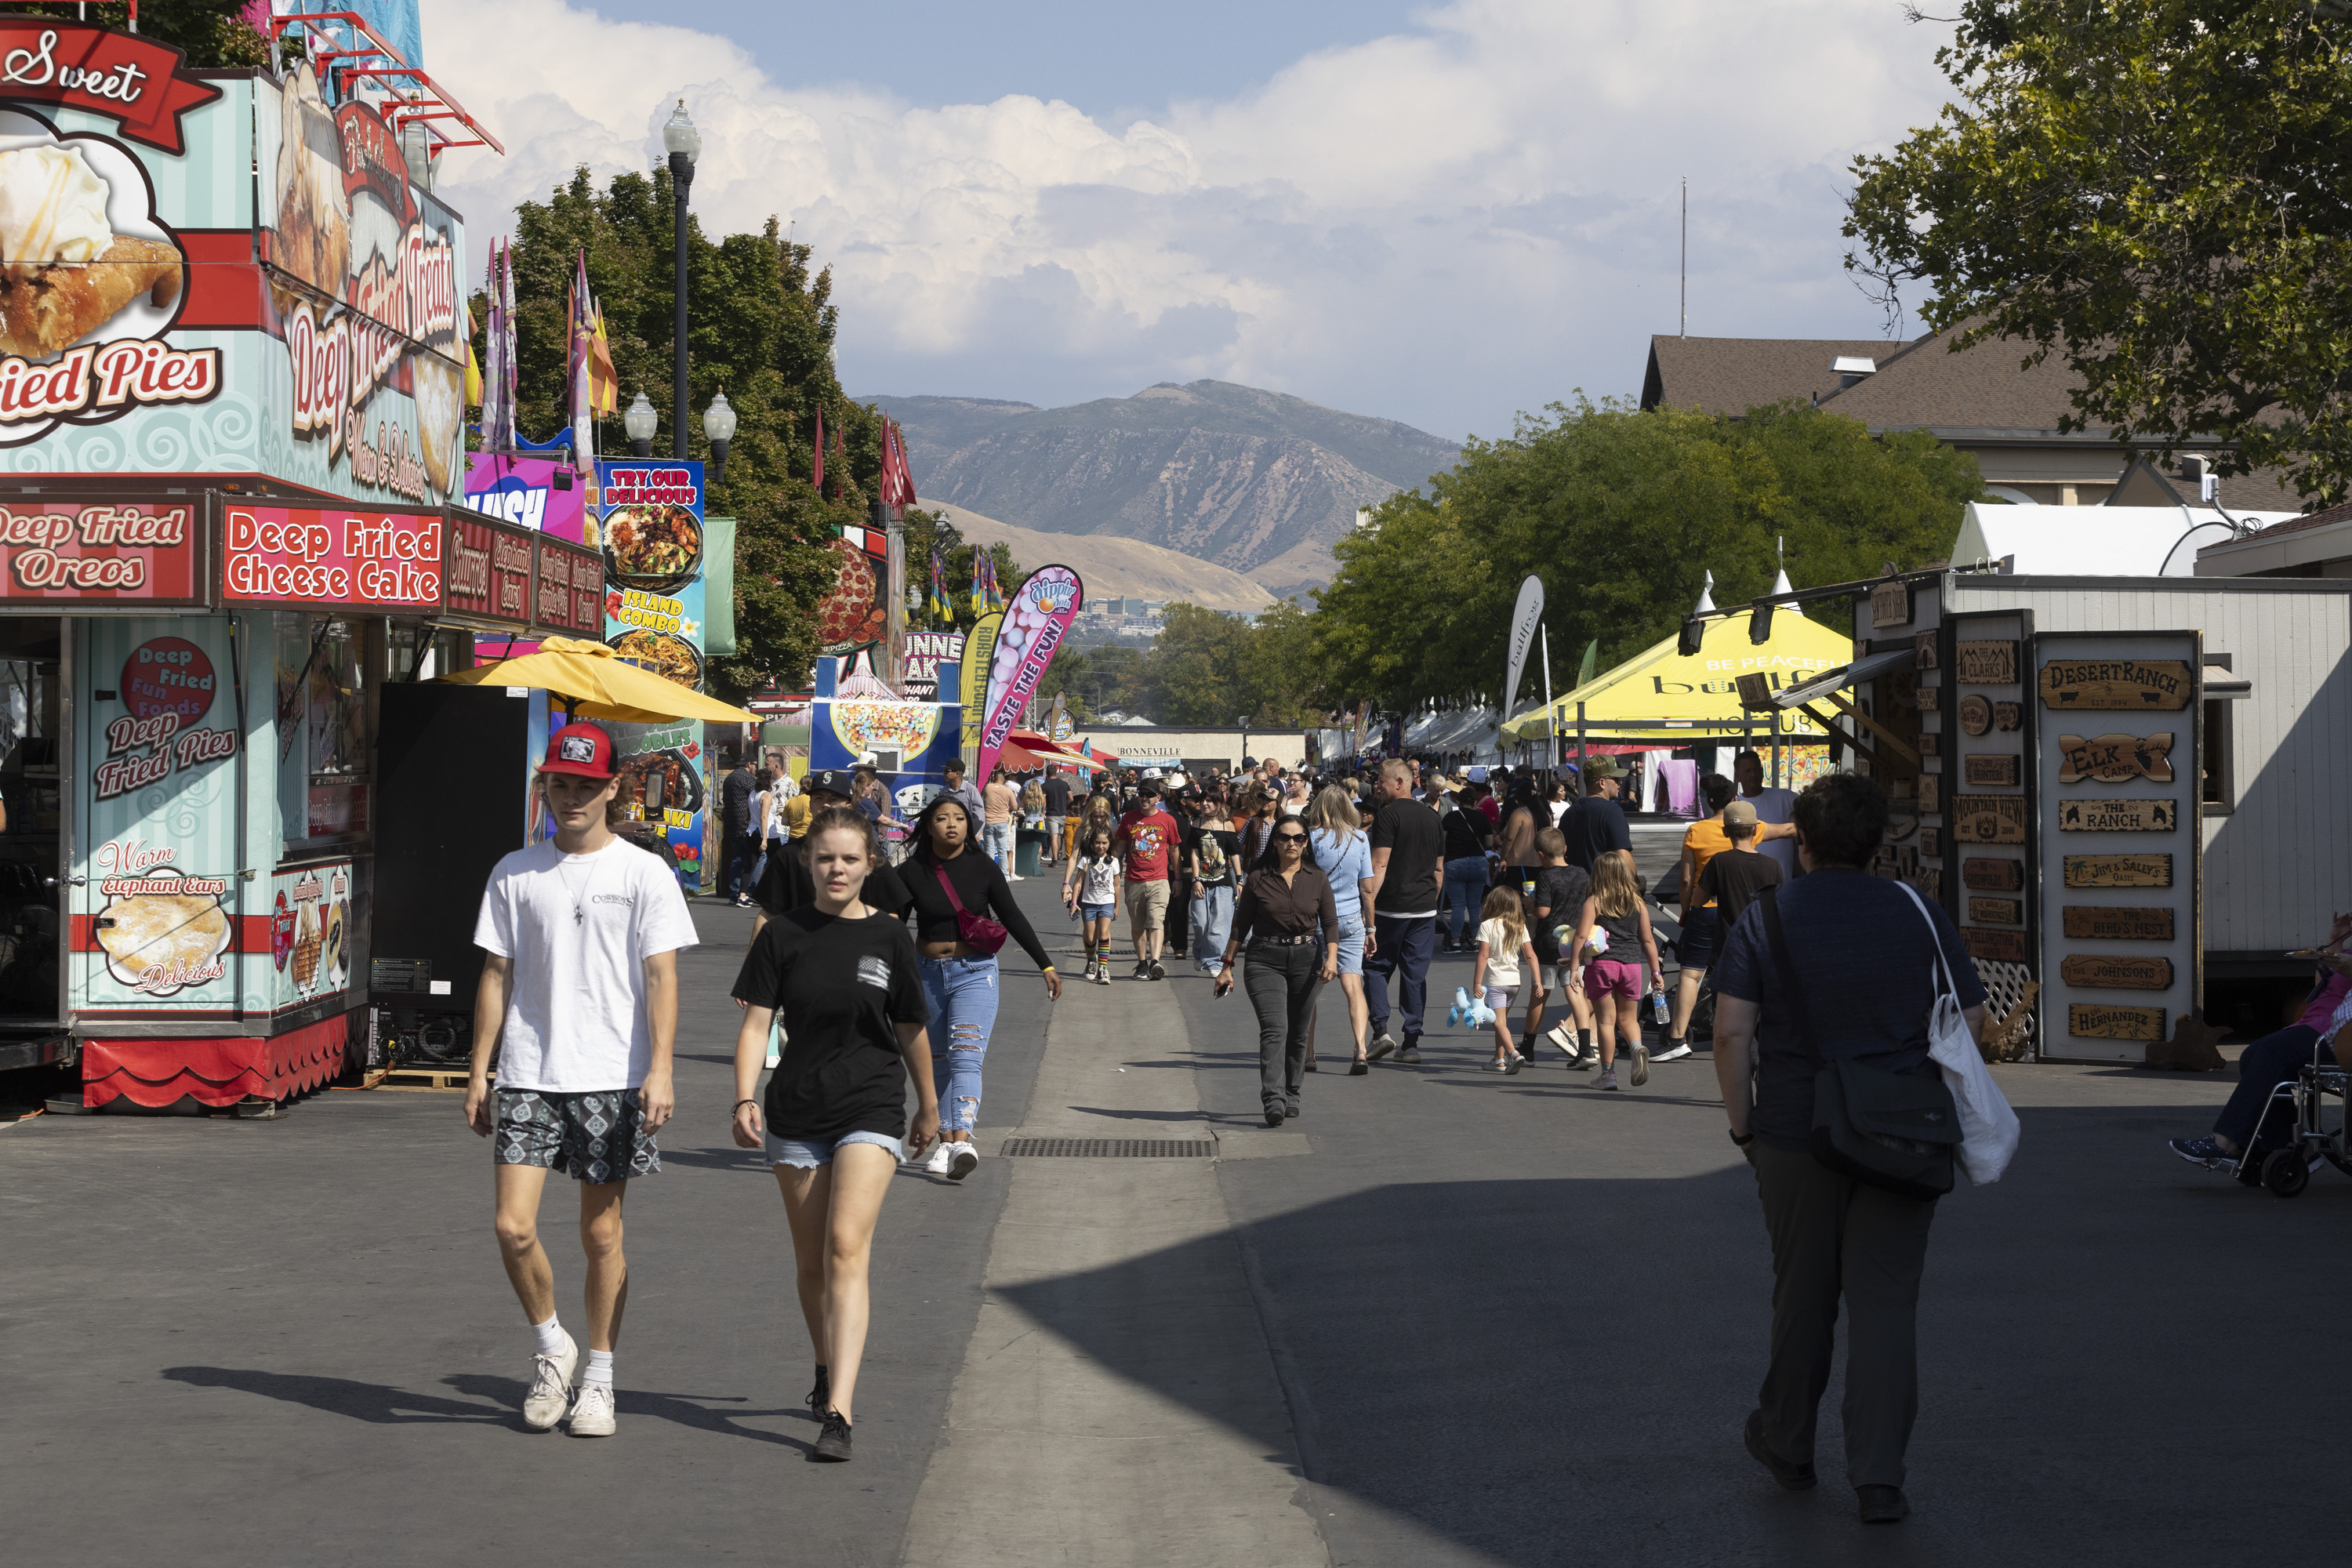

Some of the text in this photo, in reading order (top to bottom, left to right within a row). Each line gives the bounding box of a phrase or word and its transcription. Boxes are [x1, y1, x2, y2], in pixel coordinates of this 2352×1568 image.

[5, 29, 147, 103] Sweet
[293, 306, 349, 447] Deep
[408, 229, 453, 336] Treats
[0, 343, 212, 417] ied Pies
[345, 406, 377, 482] Warm
[389, 422, 424, 503] Delicious
[612, 469, 690, 488] TRY OUR
[605, 488, 695, 505] DELICIOUS
[81, 509, 185, 543] Fried
[229, 512, 441, 562] Deep Fried
[449, 531, 488, 597] Churros
[494, 533, 531, 575] Elephant
[16, 549, 143, 585] Oreos
[540, 546, 570, 586] Deep Fried
[572, 558, 601, 593] Deep Fried
[227, 554, 440, 602] Cheese Cake
[1032, 578, 1076, 601] dippin'
[501, 574, 521, 611] Ears
[557, 587, 568, 618] Pie
[622, 589, 684, 616] ISLAND
[1053, 597, 1071, 608] dots
[619, 608, 681, 634] COMBO
[1511, 597, 1539, 668] bullfrog
[1529, 612, 1537, 631] spas
[139, 647, 193, 667] Deep
[830, 642, 853, 652] PIZZA
[974, 626, 994, 684] ROASTED
[1979, 648, 1989, 659] THE
[1705, 659, 1735, 672] BE
[1968, 662, 2001, 678] CLARKS
[130, 677, 168, 701] Fun
[158, 668, 214, 691] Fried
[985, 617, 1065, 750] TASTE THE FUN!
[137, 698, 201, 717] Foods
[110, 713, 179, 750] Deep
[616, 728, 692, 757] NOODLES
[98, 730, 235, 795] Fried Pies
[1120, 747, 1181, 756] BONNEVILLE
[1130, 758, 1171, 767] FINE ARTS
[2070, 745, 2121, 775] ELK
[1974, 769, 2004, 781] HUNTERS
[1984, 759, 1993, 768] THE
[2102, 764, 2134, 779] CAMP
[1953, 798, 2024, 828] MOUNTAIN VIEW
[2103, 803, 2125, 813] THE
[2002, 826, 2015, 835] 2000
[2087, 814, 2141, 827] RANCH
[97, 838, 177, 875] Warm
[2092, 858, 2161, 879] JIM & SALLY'S
[2112, 873, 2135, 882] OASIS
[101, 875, 226, 899] Elephant Ears
[592, 894, 633, 906] COWBOYS
[2093, 921, 2165, 935] BIRD'S NEST
[2123, 912, 2141, 921] THE
[1969, 931, 2015, 946] YELLOWSTONE
[134, 958, 225, 993] Delicious
[2093, 965, 2155, 978] JOHNSONS
[2078, 1011, 2148, 1031] HERNANDEZ
[2089, 1007, 2102, 1016] LOS
